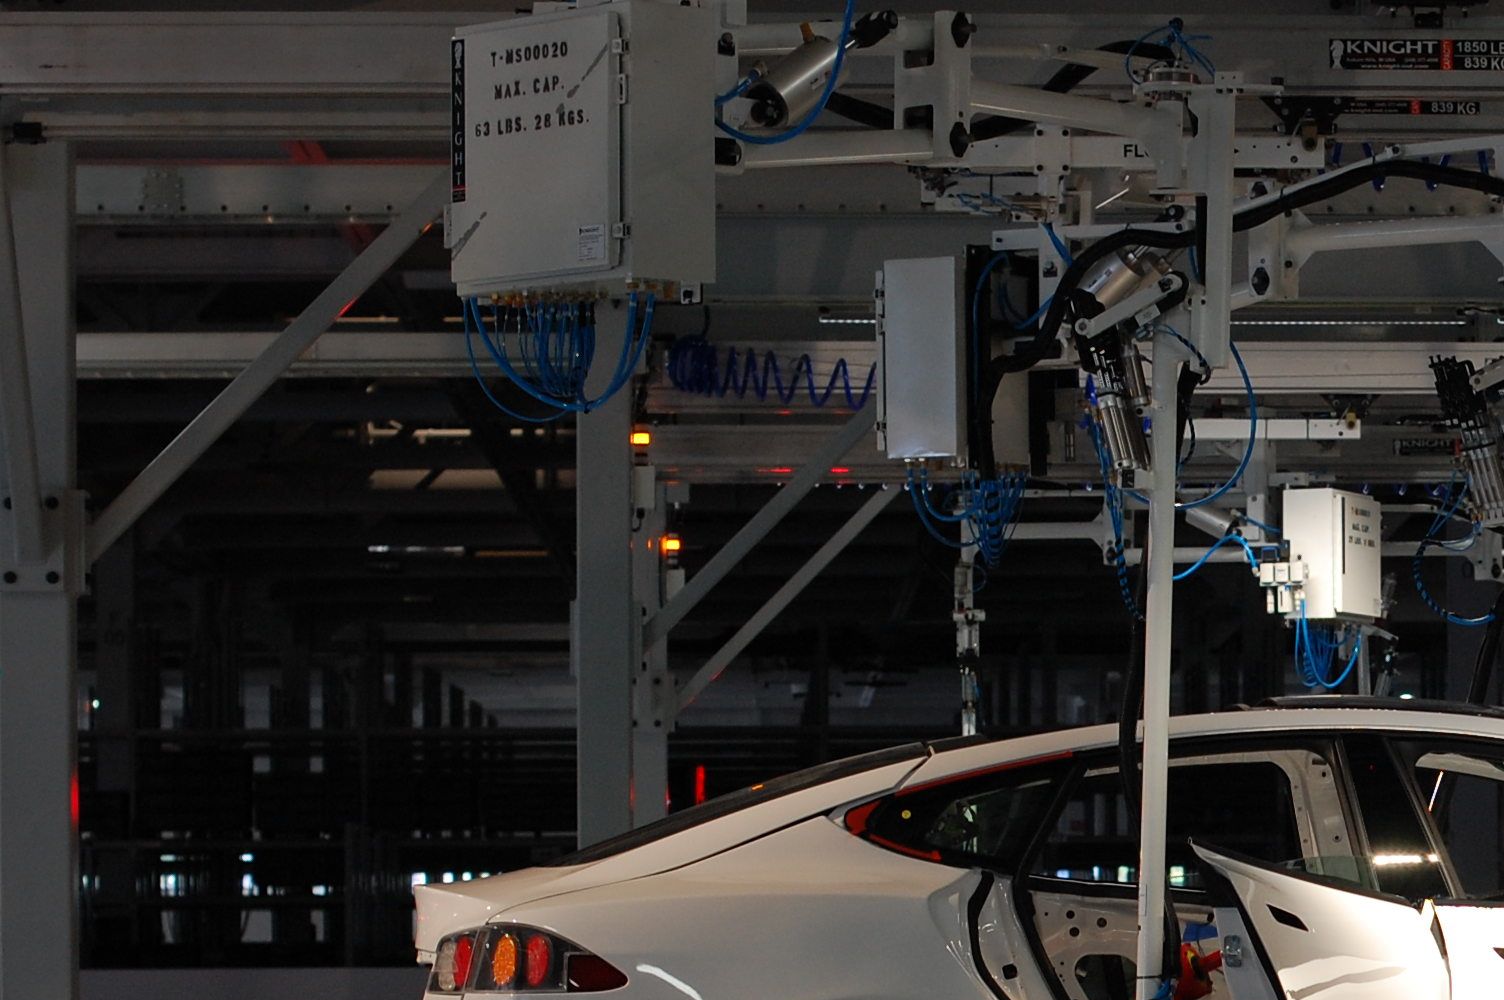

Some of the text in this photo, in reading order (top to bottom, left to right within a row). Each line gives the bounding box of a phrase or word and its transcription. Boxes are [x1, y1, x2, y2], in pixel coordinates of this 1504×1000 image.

[1346, 41, 1438, 54] KNIGHT
[1455, 41, 1487, 53] 1850
[1464, 57, 1487, 68] 839
[495, 76, 565, 100] MAX. CAP.
[1431, 102, 1453, 113] 839
[1457, 102, 1479, 114] KG.
[454, 71, 463, 185] KNIGHT
[475, 109, 589, 137] 63 LBS. 28 KGS.
